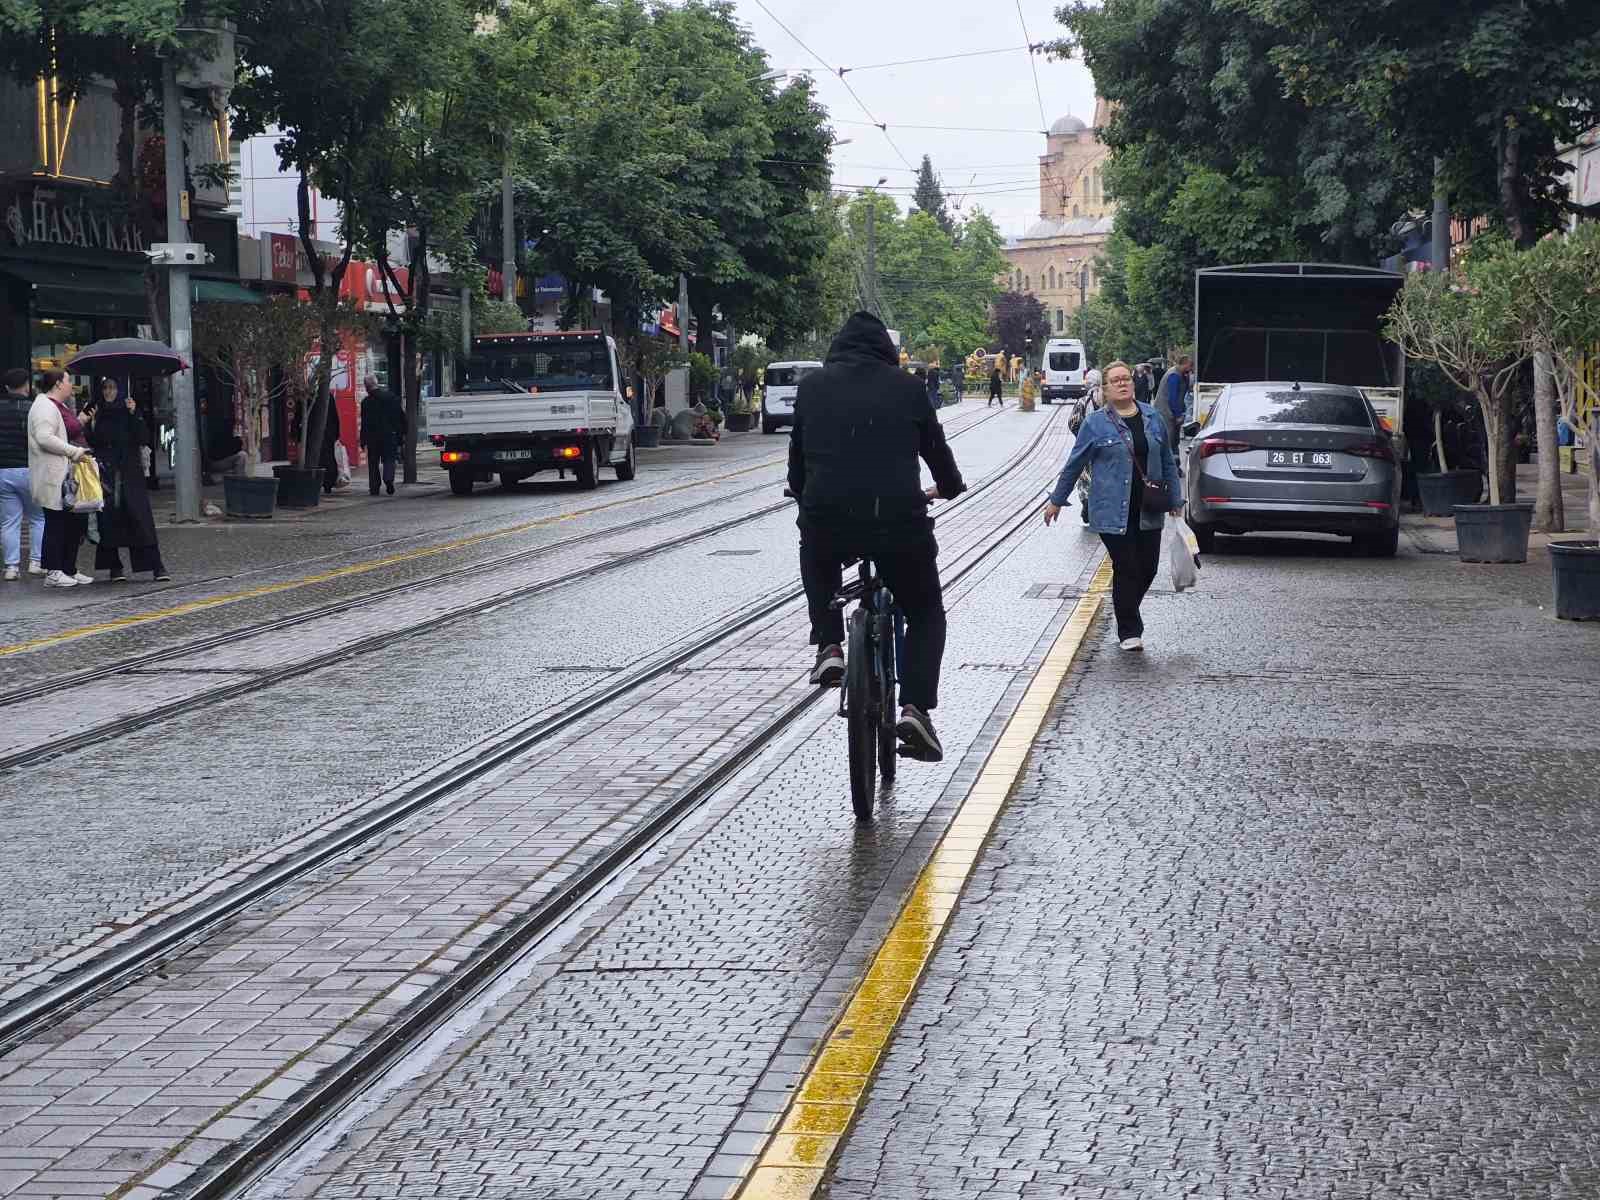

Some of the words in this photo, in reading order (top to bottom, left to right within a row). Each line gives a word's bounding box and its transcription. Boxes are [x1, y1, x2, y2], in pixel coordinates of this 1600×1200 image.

[32, 200, 101, 248] HASAN
[1272, 452, 1285, 463] 26
[1292, 452, 1305, 463] ET
[1312, 453, 1330, 464] 063
